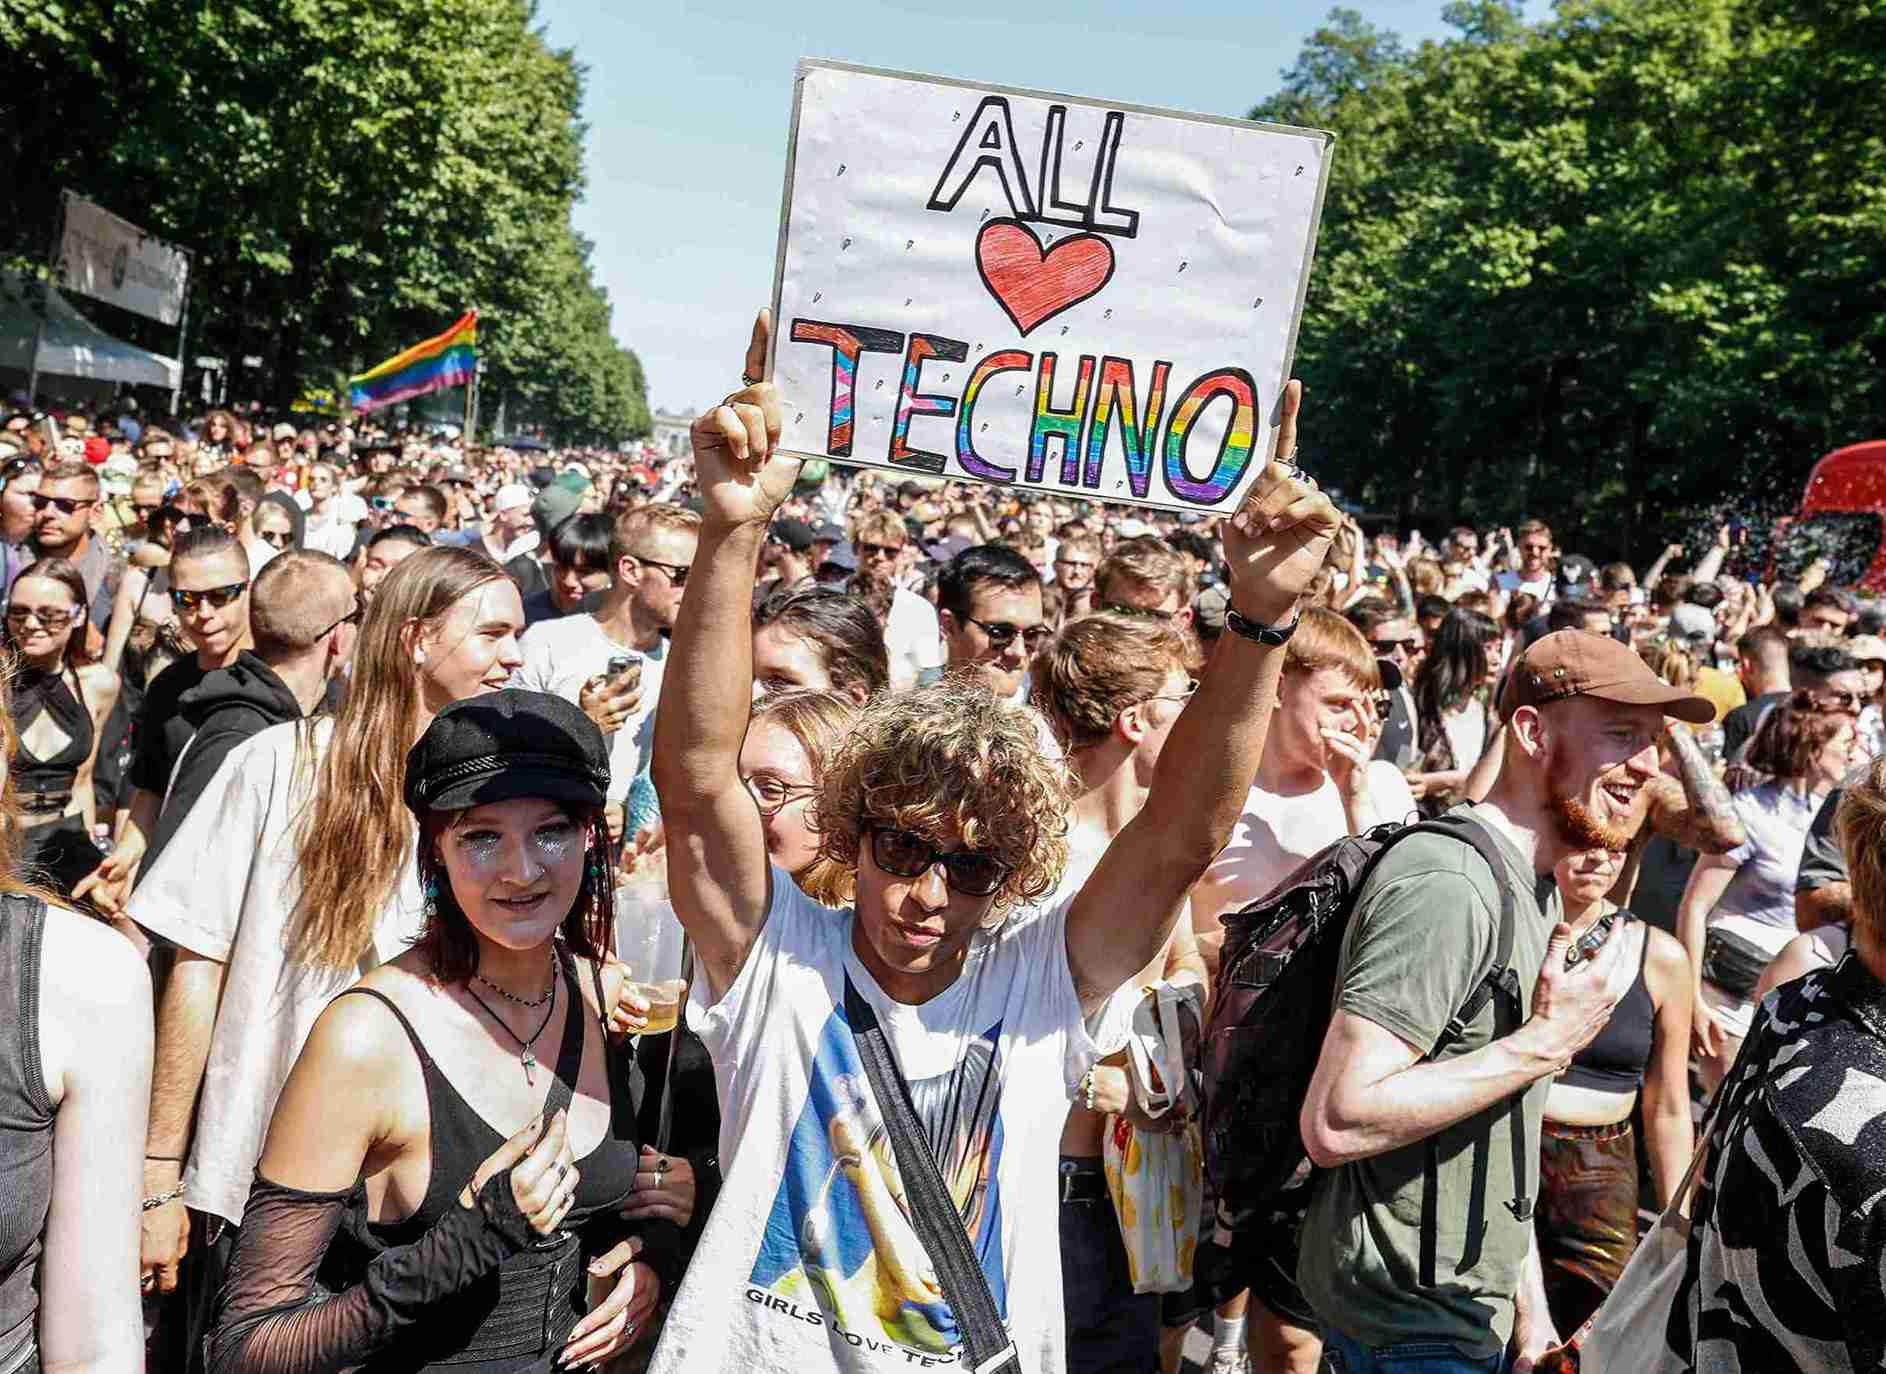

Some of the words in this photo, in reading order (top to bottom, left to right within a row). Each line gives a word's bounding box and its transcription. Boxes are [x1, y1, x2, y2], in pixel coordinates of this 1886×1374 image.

[926, 95, 1139, 239] ALL
[790, 317, 1259, 505] TECHNO
[745, 1288, 824, 1326] GIRLS
[831, 1319, 893, 1354] LOVE
